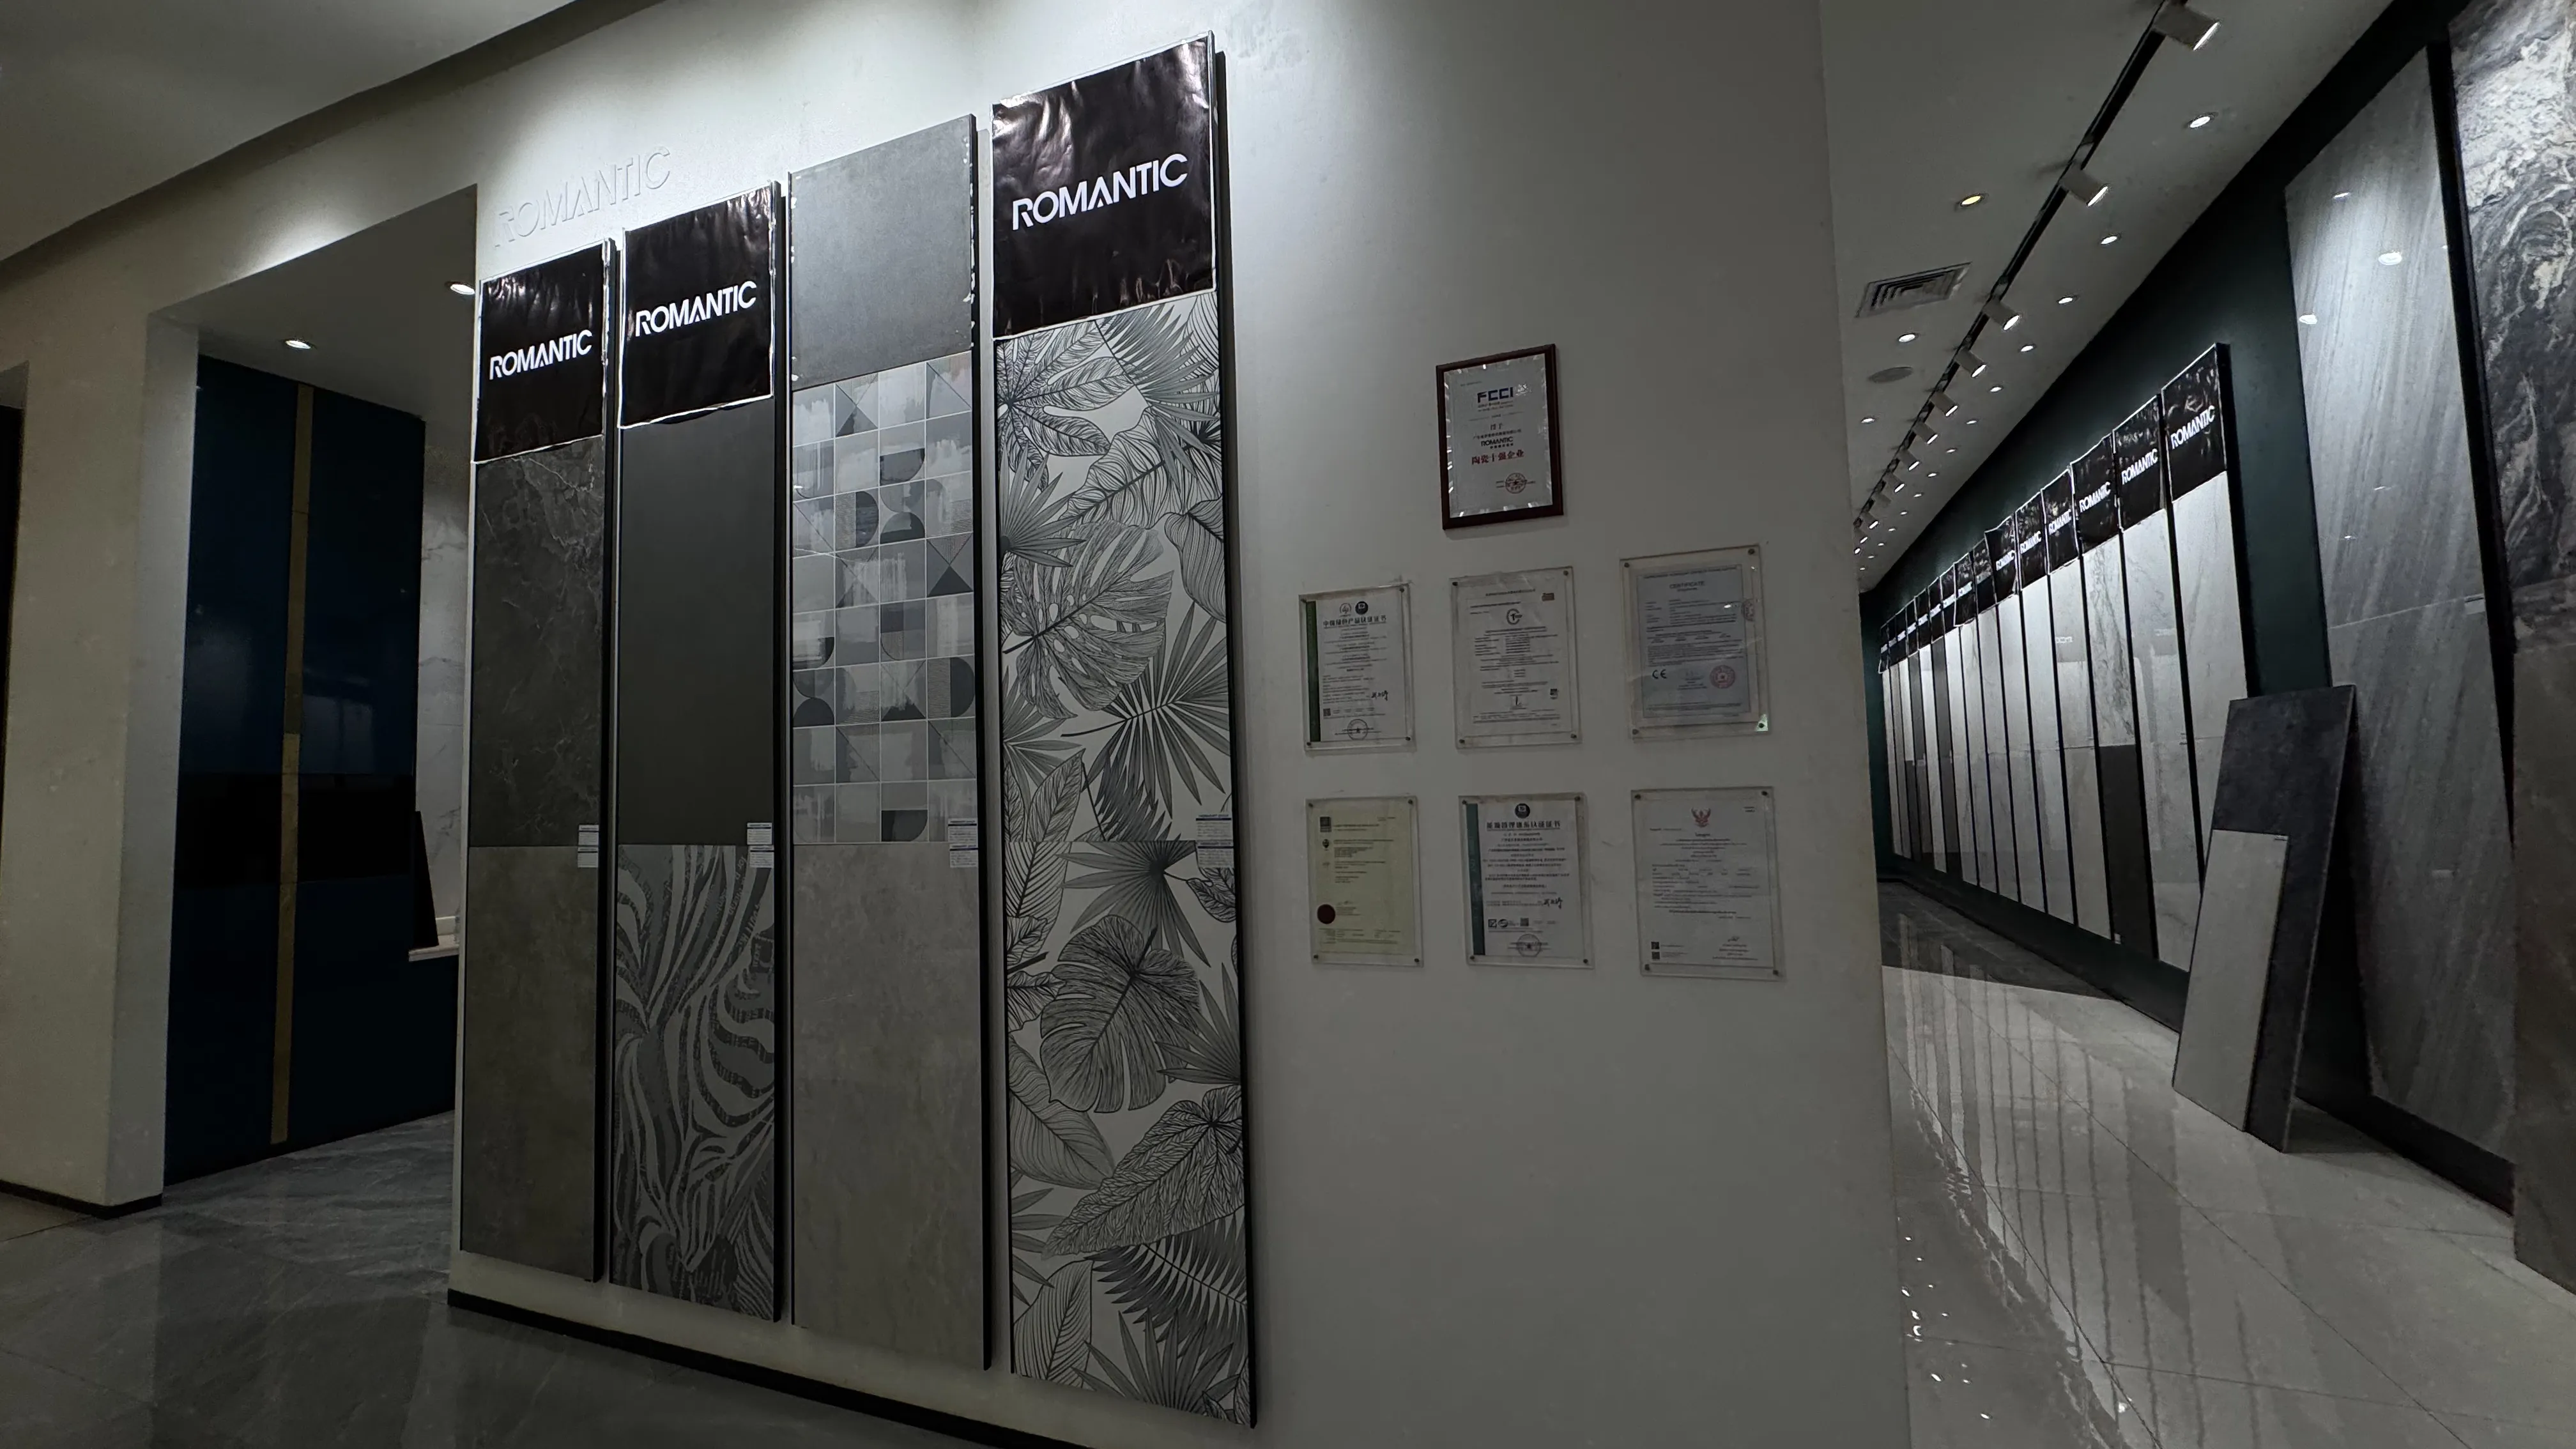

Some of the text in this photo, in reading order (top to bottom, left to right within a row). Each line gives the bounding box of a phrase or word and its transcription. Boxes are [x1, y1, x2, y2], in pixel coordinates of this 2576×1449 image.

[495, 146, 671, 247] ROMANTIC
[1013, 153, 1188, 231] ROMANTIC
[634, 280, 757, 337] ROMANTIC
[489, 330, 593, 380] ROMANTIC
[1477, 387, 1514, 402] FCCI
[1481, 436, 1514, 447] ROMANTIC
[2170, 405, 2216, 449] ROMANTIC
[1471, 449, 1524, 465] 陶瓷十强企业
[2121, 448, 2158, 484] ROMANTIC
[2079, 482, 2111, 513] ROMANTIC
[1669, 581, 1705, 590] CERTIFICATE
